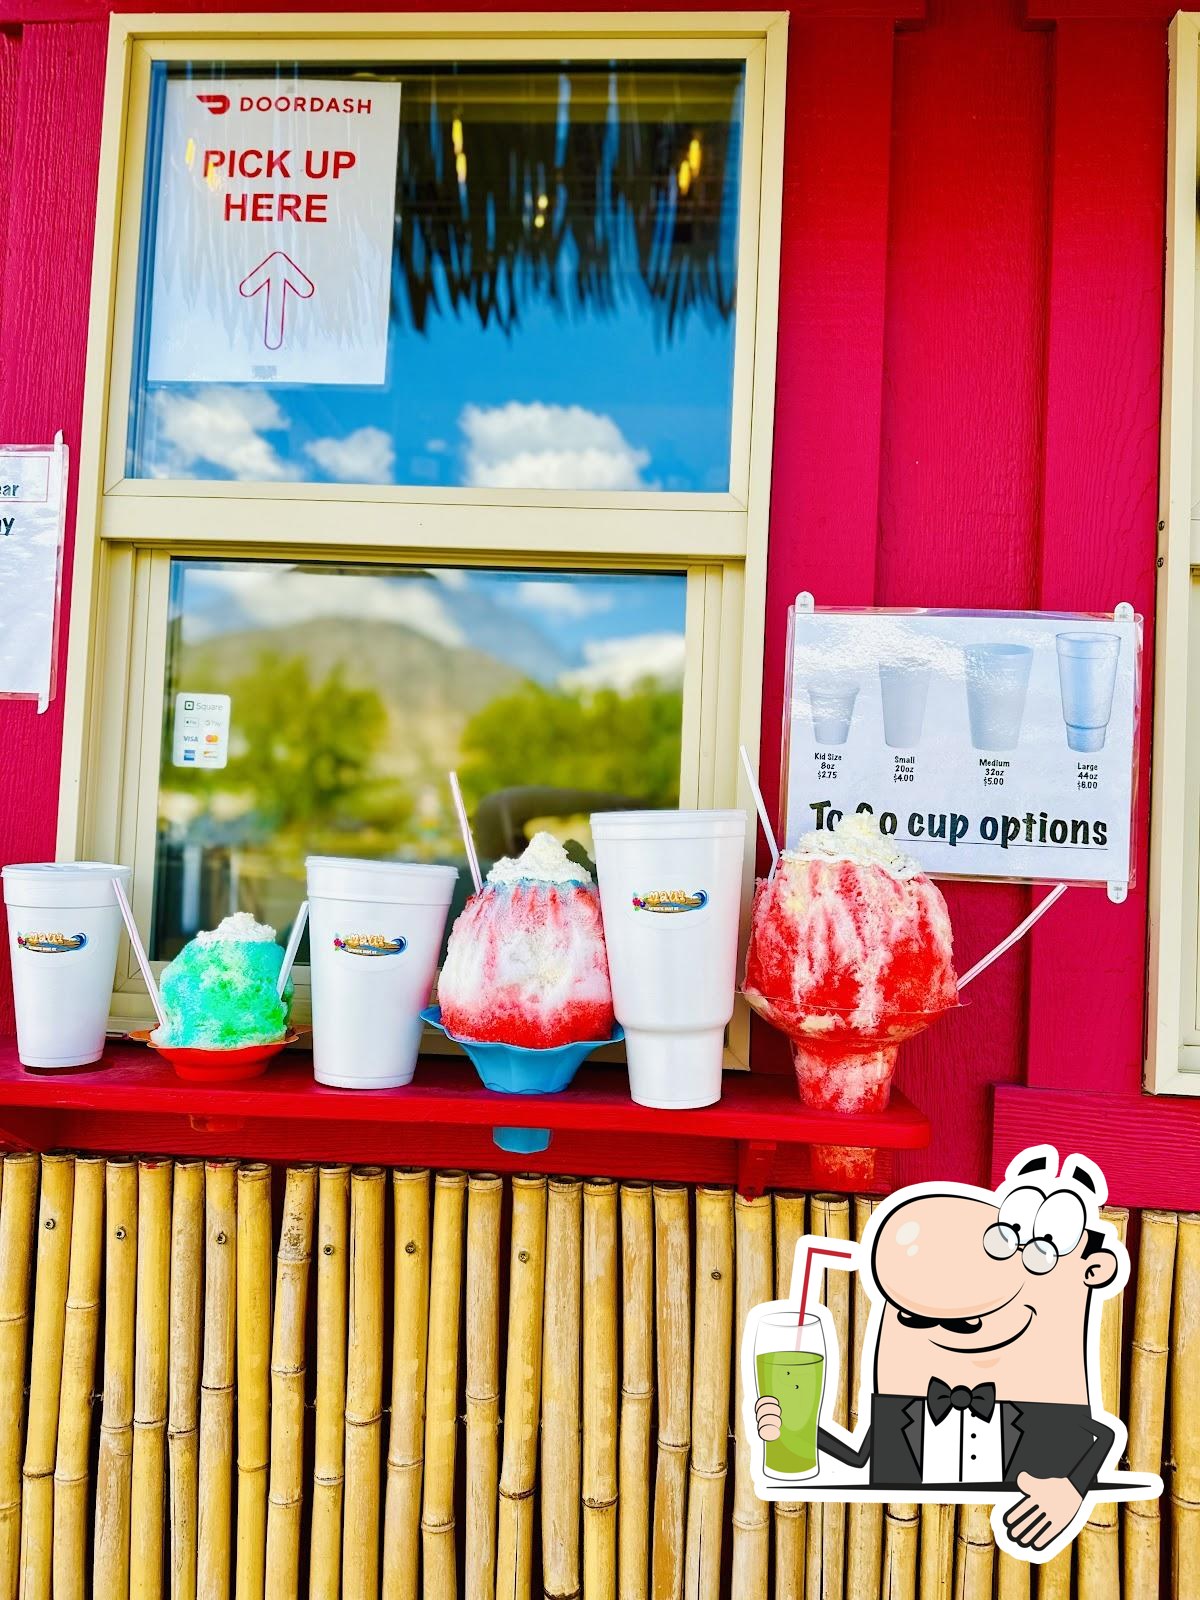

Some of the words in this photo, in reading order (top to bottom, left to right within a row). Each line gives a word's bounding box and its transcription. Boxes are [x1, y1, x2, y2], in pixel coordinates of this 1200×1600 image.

[239, 96, 372, 114] DOORDASH
[203, 149, 292, 179] PICK
[305, 150, 356, 179] UP
[224, 193, 328, 222] HERE
[814, 752, 825, 760] Kid
[827, 753, 842, 761] Size
[894, 755, 915, 764] Small
[820, 762, 835, 770] 8oz
[979, 758, 1010, 767] Medium
[1077, 762, 1098, 771] Large
[895, 765, 914, 773] 20oz
[984, 768, 1004, 776] 32oz
[893, 773, 914, 783] $4.00
[1077, 772, 1098, 780] 44oz
[983, 776, 1004, 787] $5.00
[907, 812, 969, 847] cup
[979, 812, 1108, 849] options
